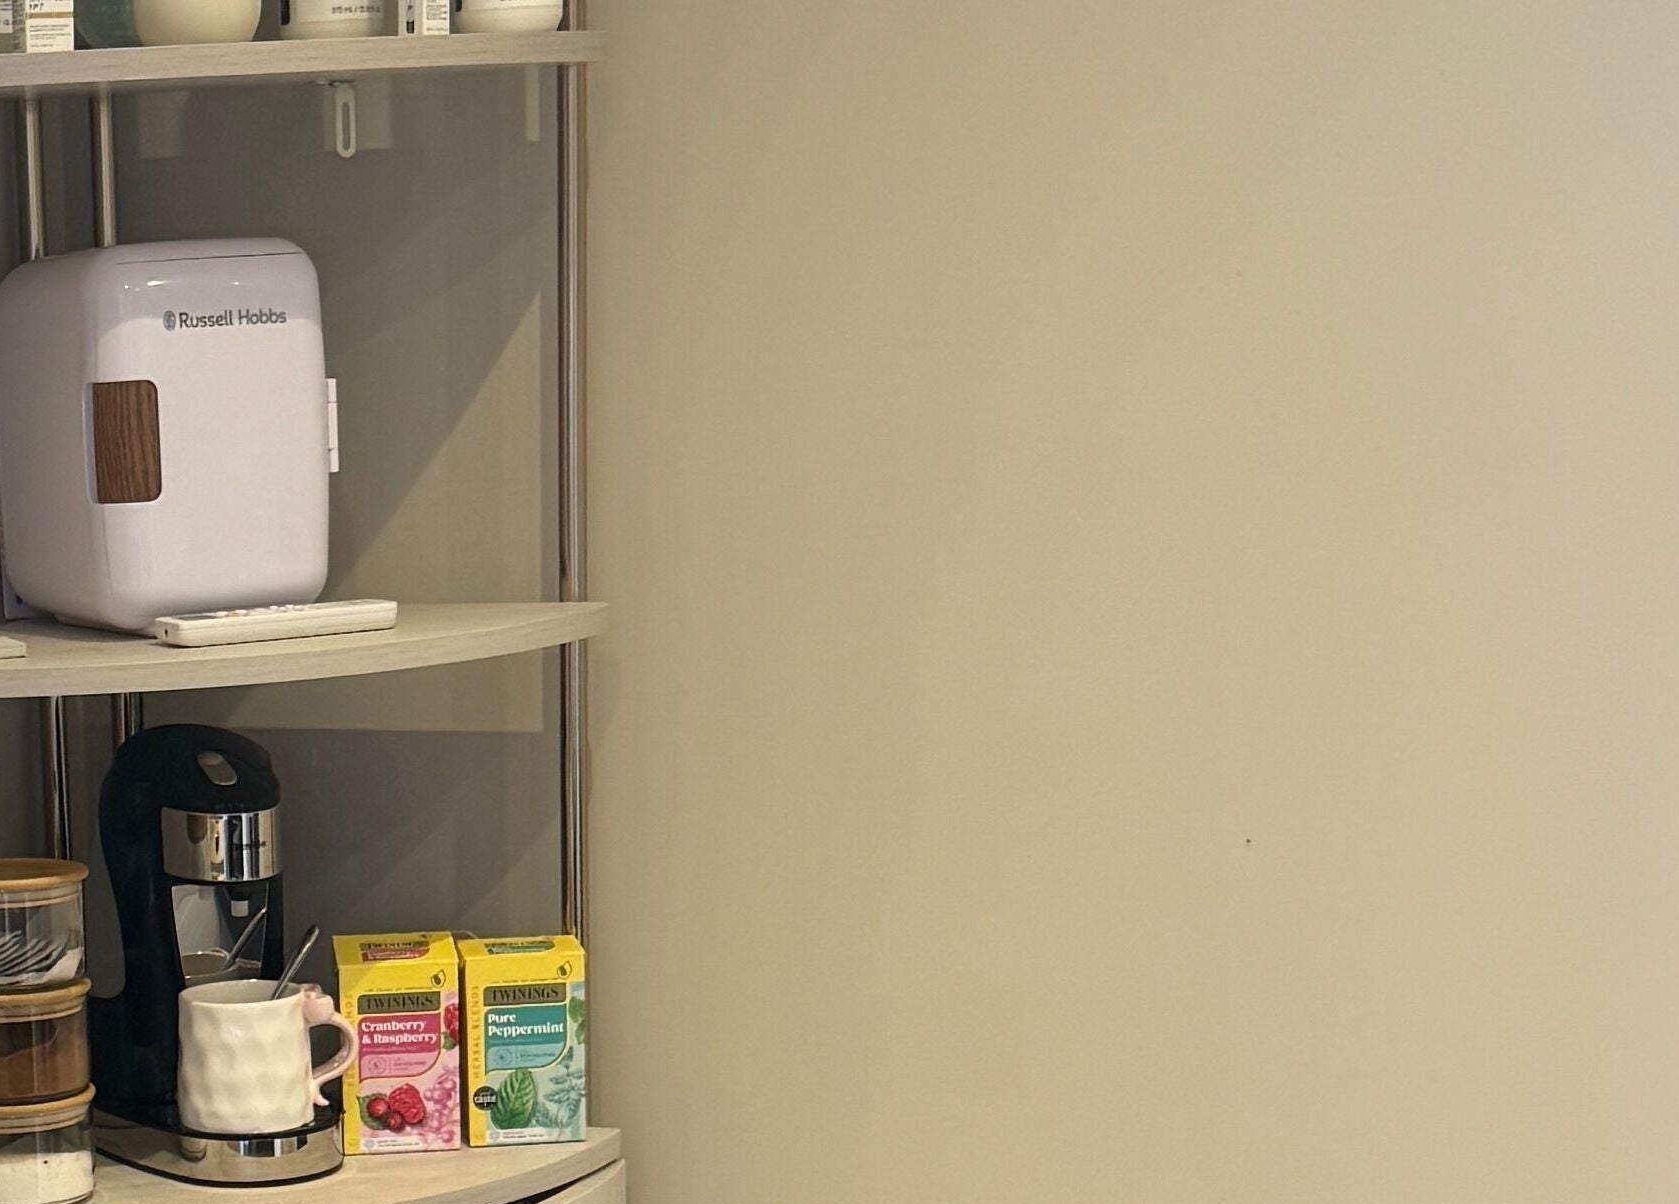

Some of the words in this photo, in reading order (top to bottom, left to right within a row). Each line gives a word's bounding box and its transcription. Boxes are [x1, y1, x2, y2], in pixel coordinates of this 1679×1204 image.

[178, 309, 233, 328] Russell
[238, 307, 287, 325] Hobbs
[492, 986, 559, 1001] TWININGS
[366, 995, 433, 1010] TWININGS
[488, 1013, 516, 1023] Pure
[362, 1020, 426, 1032] Cranberry
[488, 1022, 564, 1038] Peppermint
[362, 1034, 371, 1044] &
[373, 1033, 439, 1045] Raspberry
